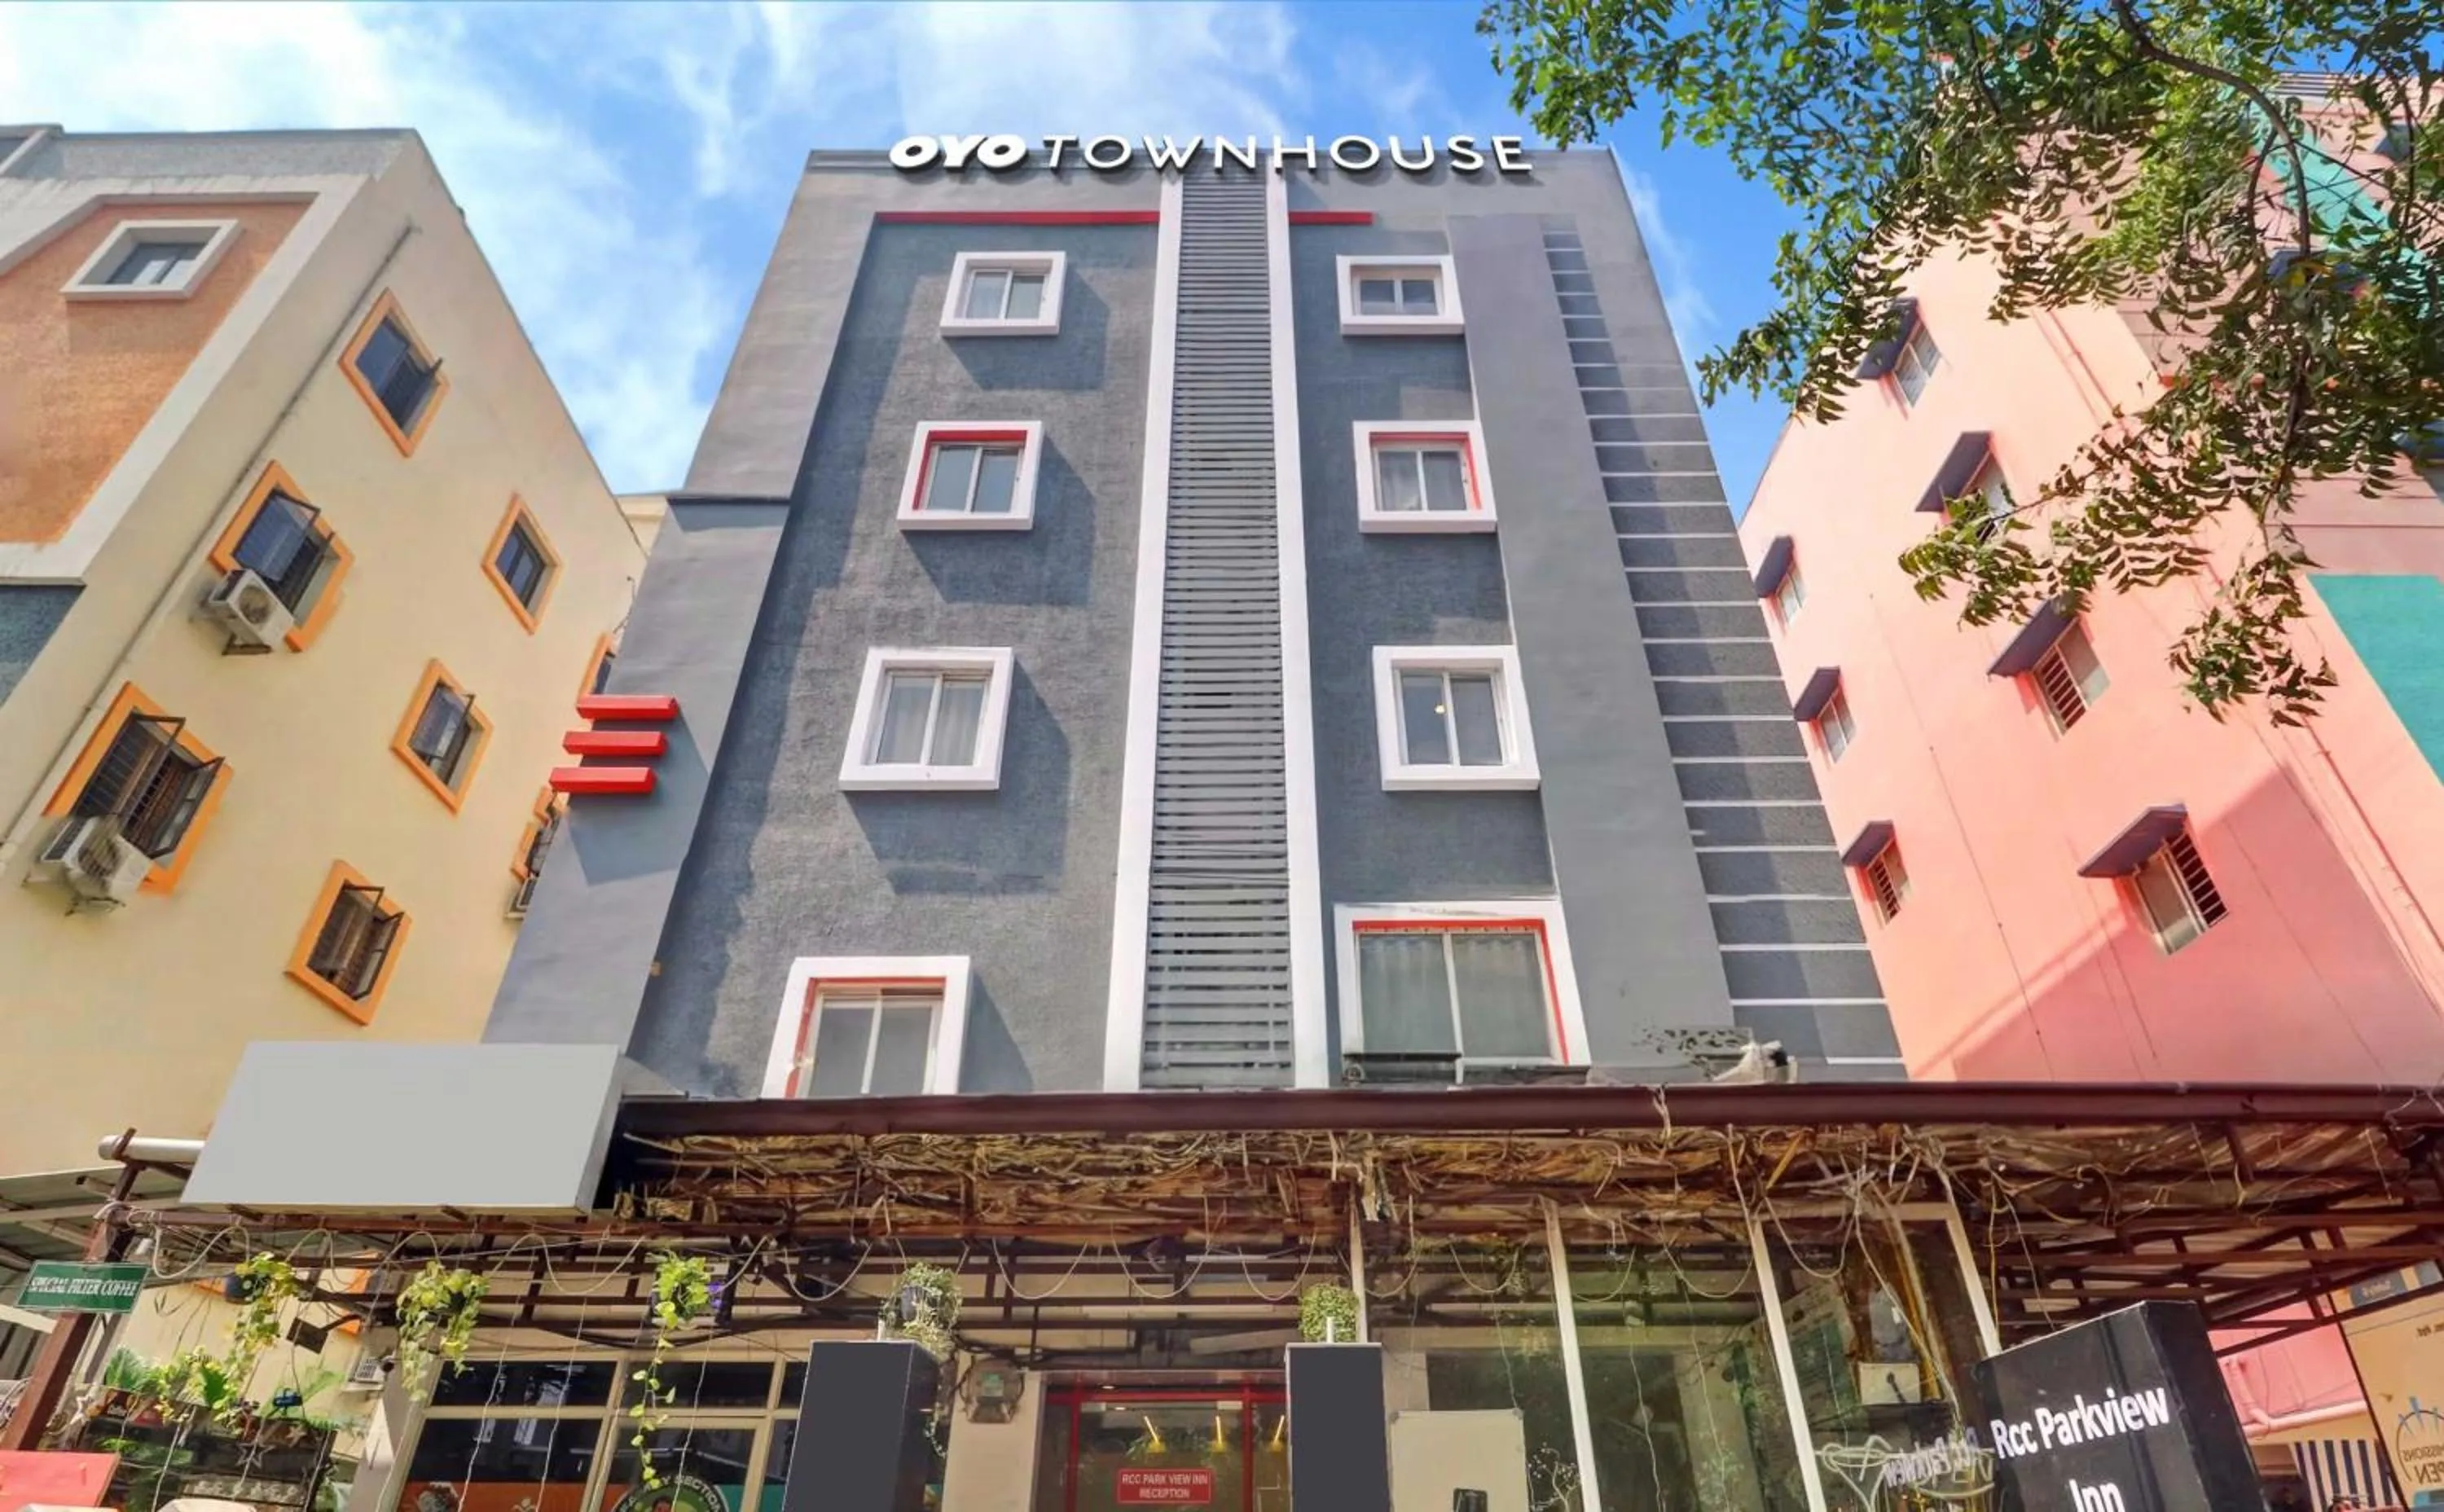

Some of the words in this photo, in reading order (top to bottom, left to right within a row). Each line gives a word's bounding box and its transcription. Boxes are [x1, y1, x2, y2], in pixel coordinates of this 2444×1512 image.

[890, 134, 1028, 170] OYO
[1044, 134, 1533, 171] TOWNHOUSE
[28, 1277, 68, 1294] SPECIAL
[68, 1278, 103, 1294] FILTER
[100, 1280, 139, 1297] COFFEE
[1990, 1418, 2038, 1460] Rcc
[2034, 1387, 2169, 1449] Parkview
[1122, 1473, 1141, 1484] RCC
[1143, 1473, 1167, 1484] PARK
[1168, 1473, 1192, 1485] VIEW
[1192, 1473, 1208, 1485] INN
[1139, 1488, 1190, 1499] RECEPTION
